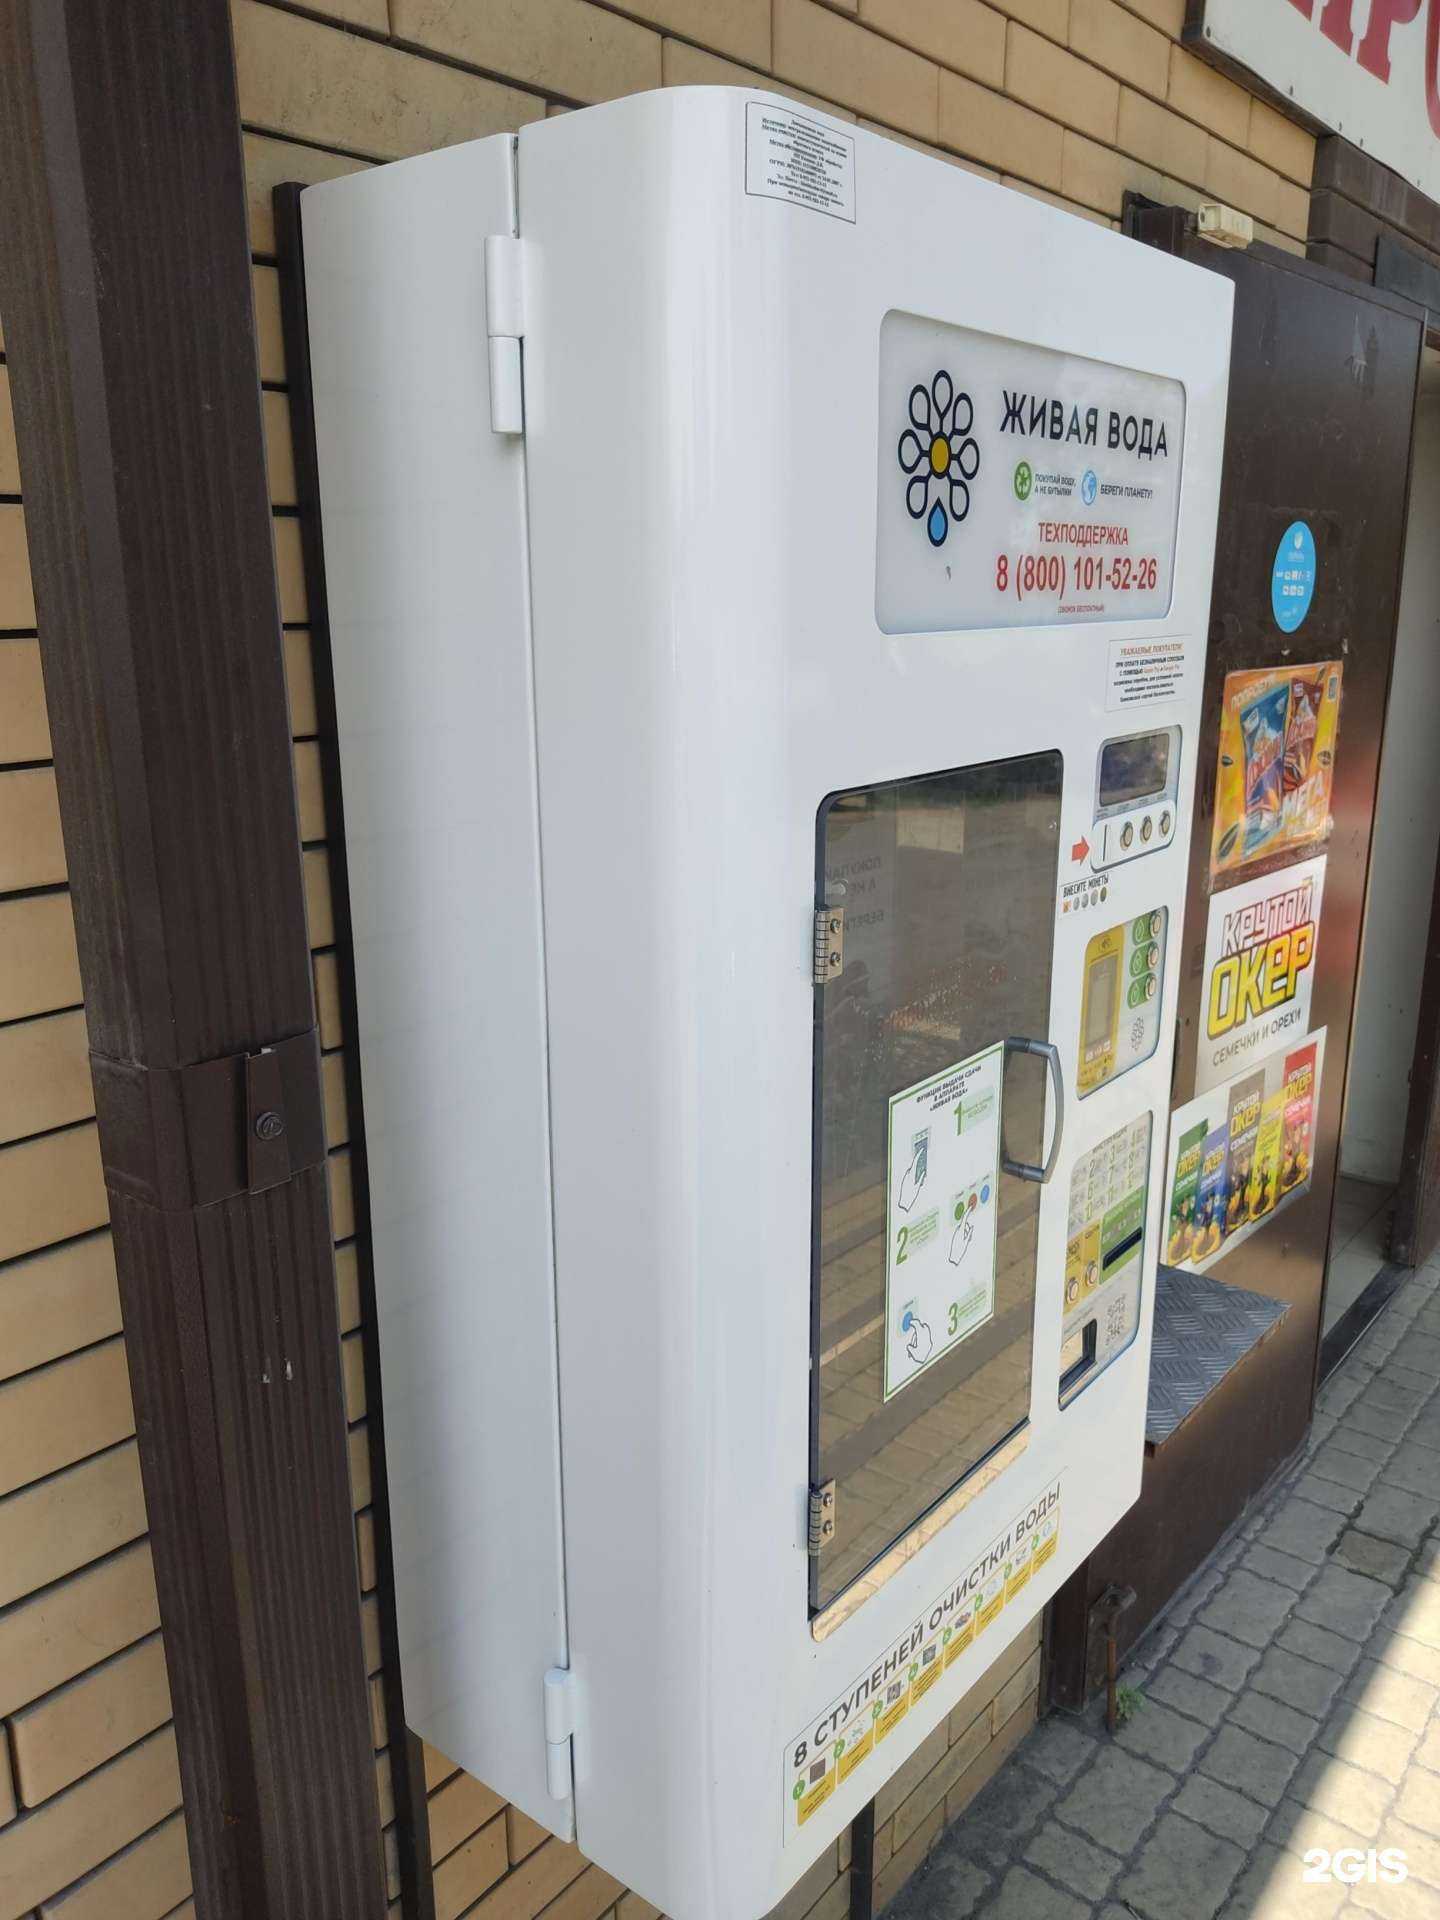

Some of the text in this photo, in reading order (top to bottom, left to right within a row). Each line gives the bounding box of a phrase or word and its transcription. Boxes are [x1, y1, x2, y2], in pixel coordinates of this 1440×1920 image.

[999, 390, 1168, 461] ЖИВАЯ ВОДА
[1035, 473, 1060, 485] ПОКУПАЙ
[1100, 484, 1124, 496] БЕРЕГИ
[1038, 521, 1129, 548] ТЕХПОДДЕРЖКА
[996, 553, 1157, 602] 8 (800) 101-52-26
[1063, 872, 1109, 898] ВНЕСИТЕ МОНЕТЫ
[1222, 877, 1314, 958] КРУТОЙ
[1212, 1008, 1301, 1067] СЕМЕЧКИ И ОРЕХИ
[965, 1064, 982, 1078] СДАЧИ
[939, 1081, 965, 1099] АППАРАТЕ
[954, 1101, 962, 1136] 1
[896, 1226, 909, 1265] 2
[948, 1302, 958, 1336] 3
[793, 1740, 808, 1768] 8
[814, 1619, 924, 1746] СТУПЕНЕЙ
[929, 1534, 1011, 1631] ОЧИСТКИ
[1015, 1481, 1060, 1544] ВОДЫ
